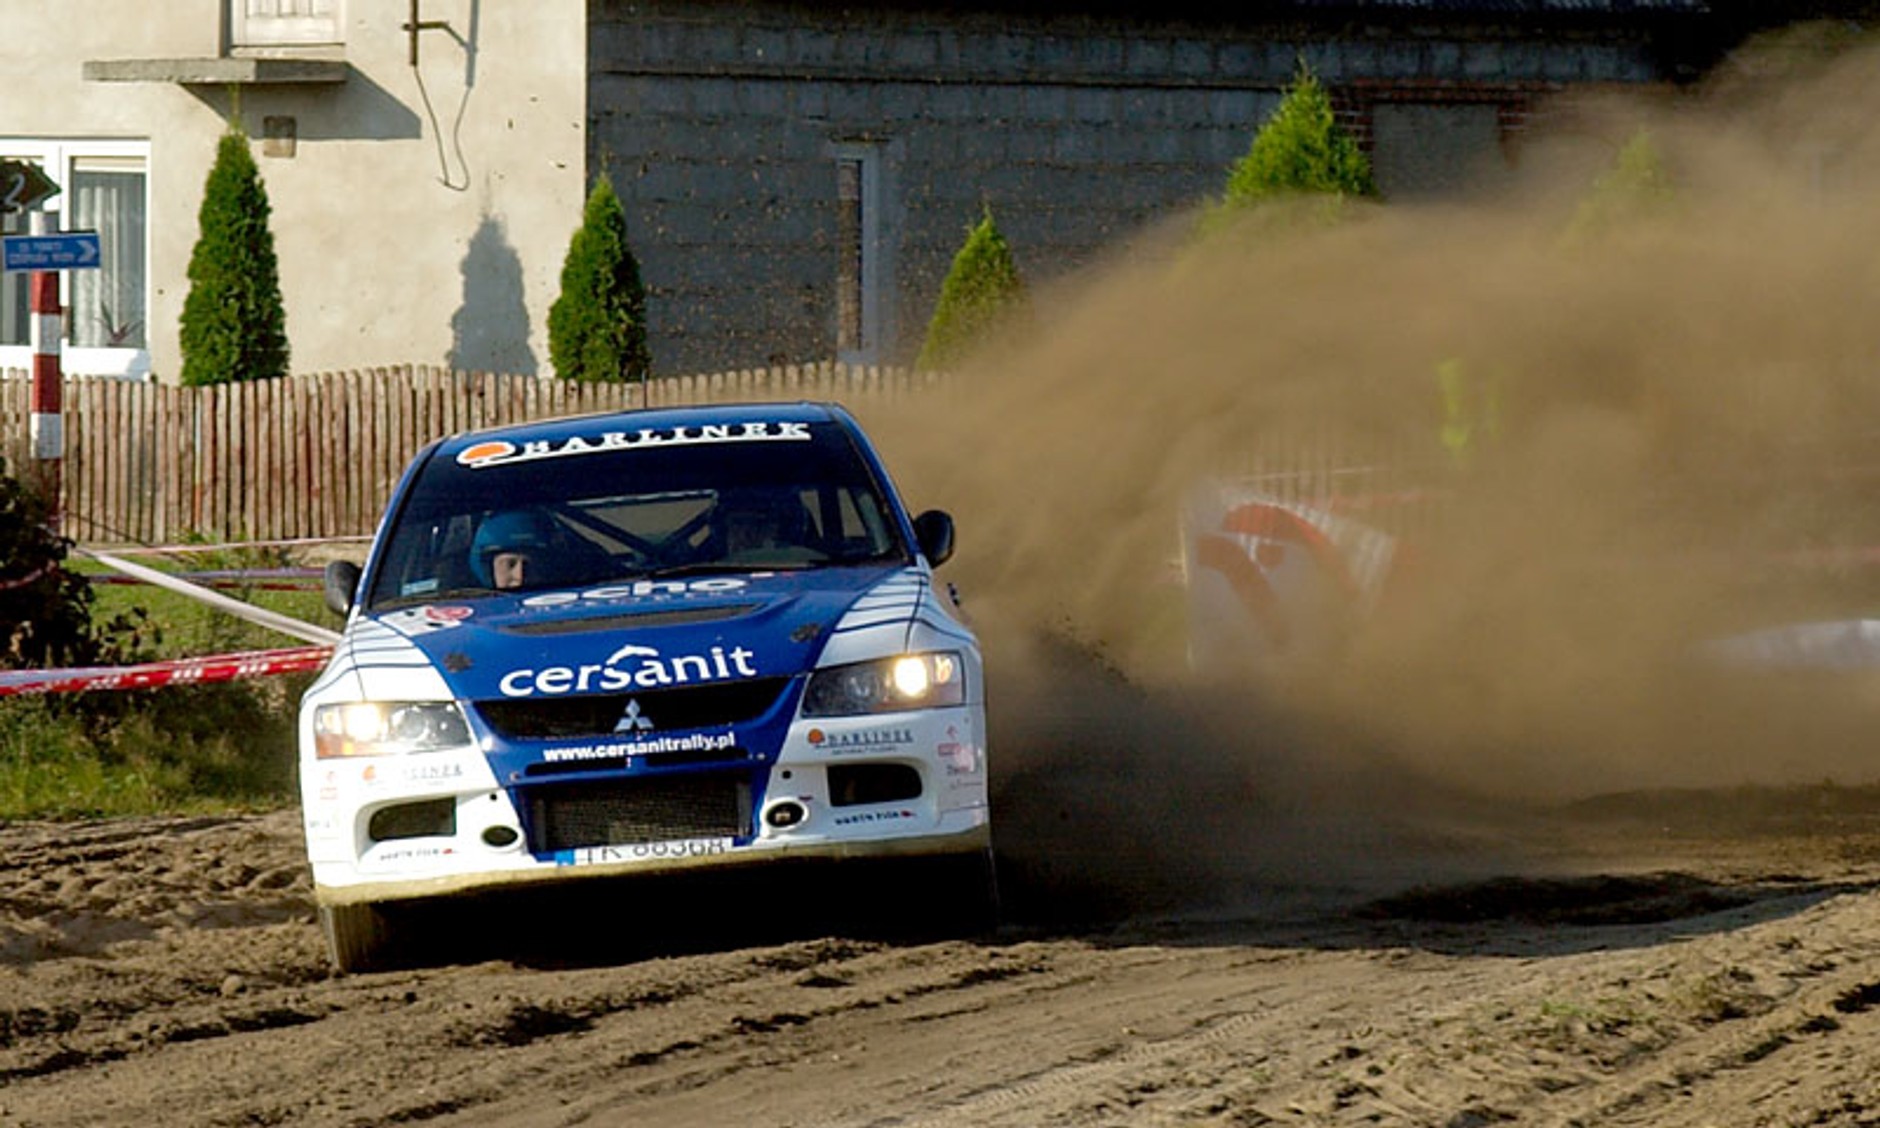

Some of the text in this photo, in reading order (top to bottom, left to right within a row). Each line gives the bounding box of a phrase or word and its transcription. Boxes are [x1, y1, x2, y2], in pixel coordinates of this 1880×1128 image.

[523, 422, 813, 456] BARLINEK
[499, 645, 758, 698] cersanit
[543, 731, 736, 762] www.cersanitrally.pl
